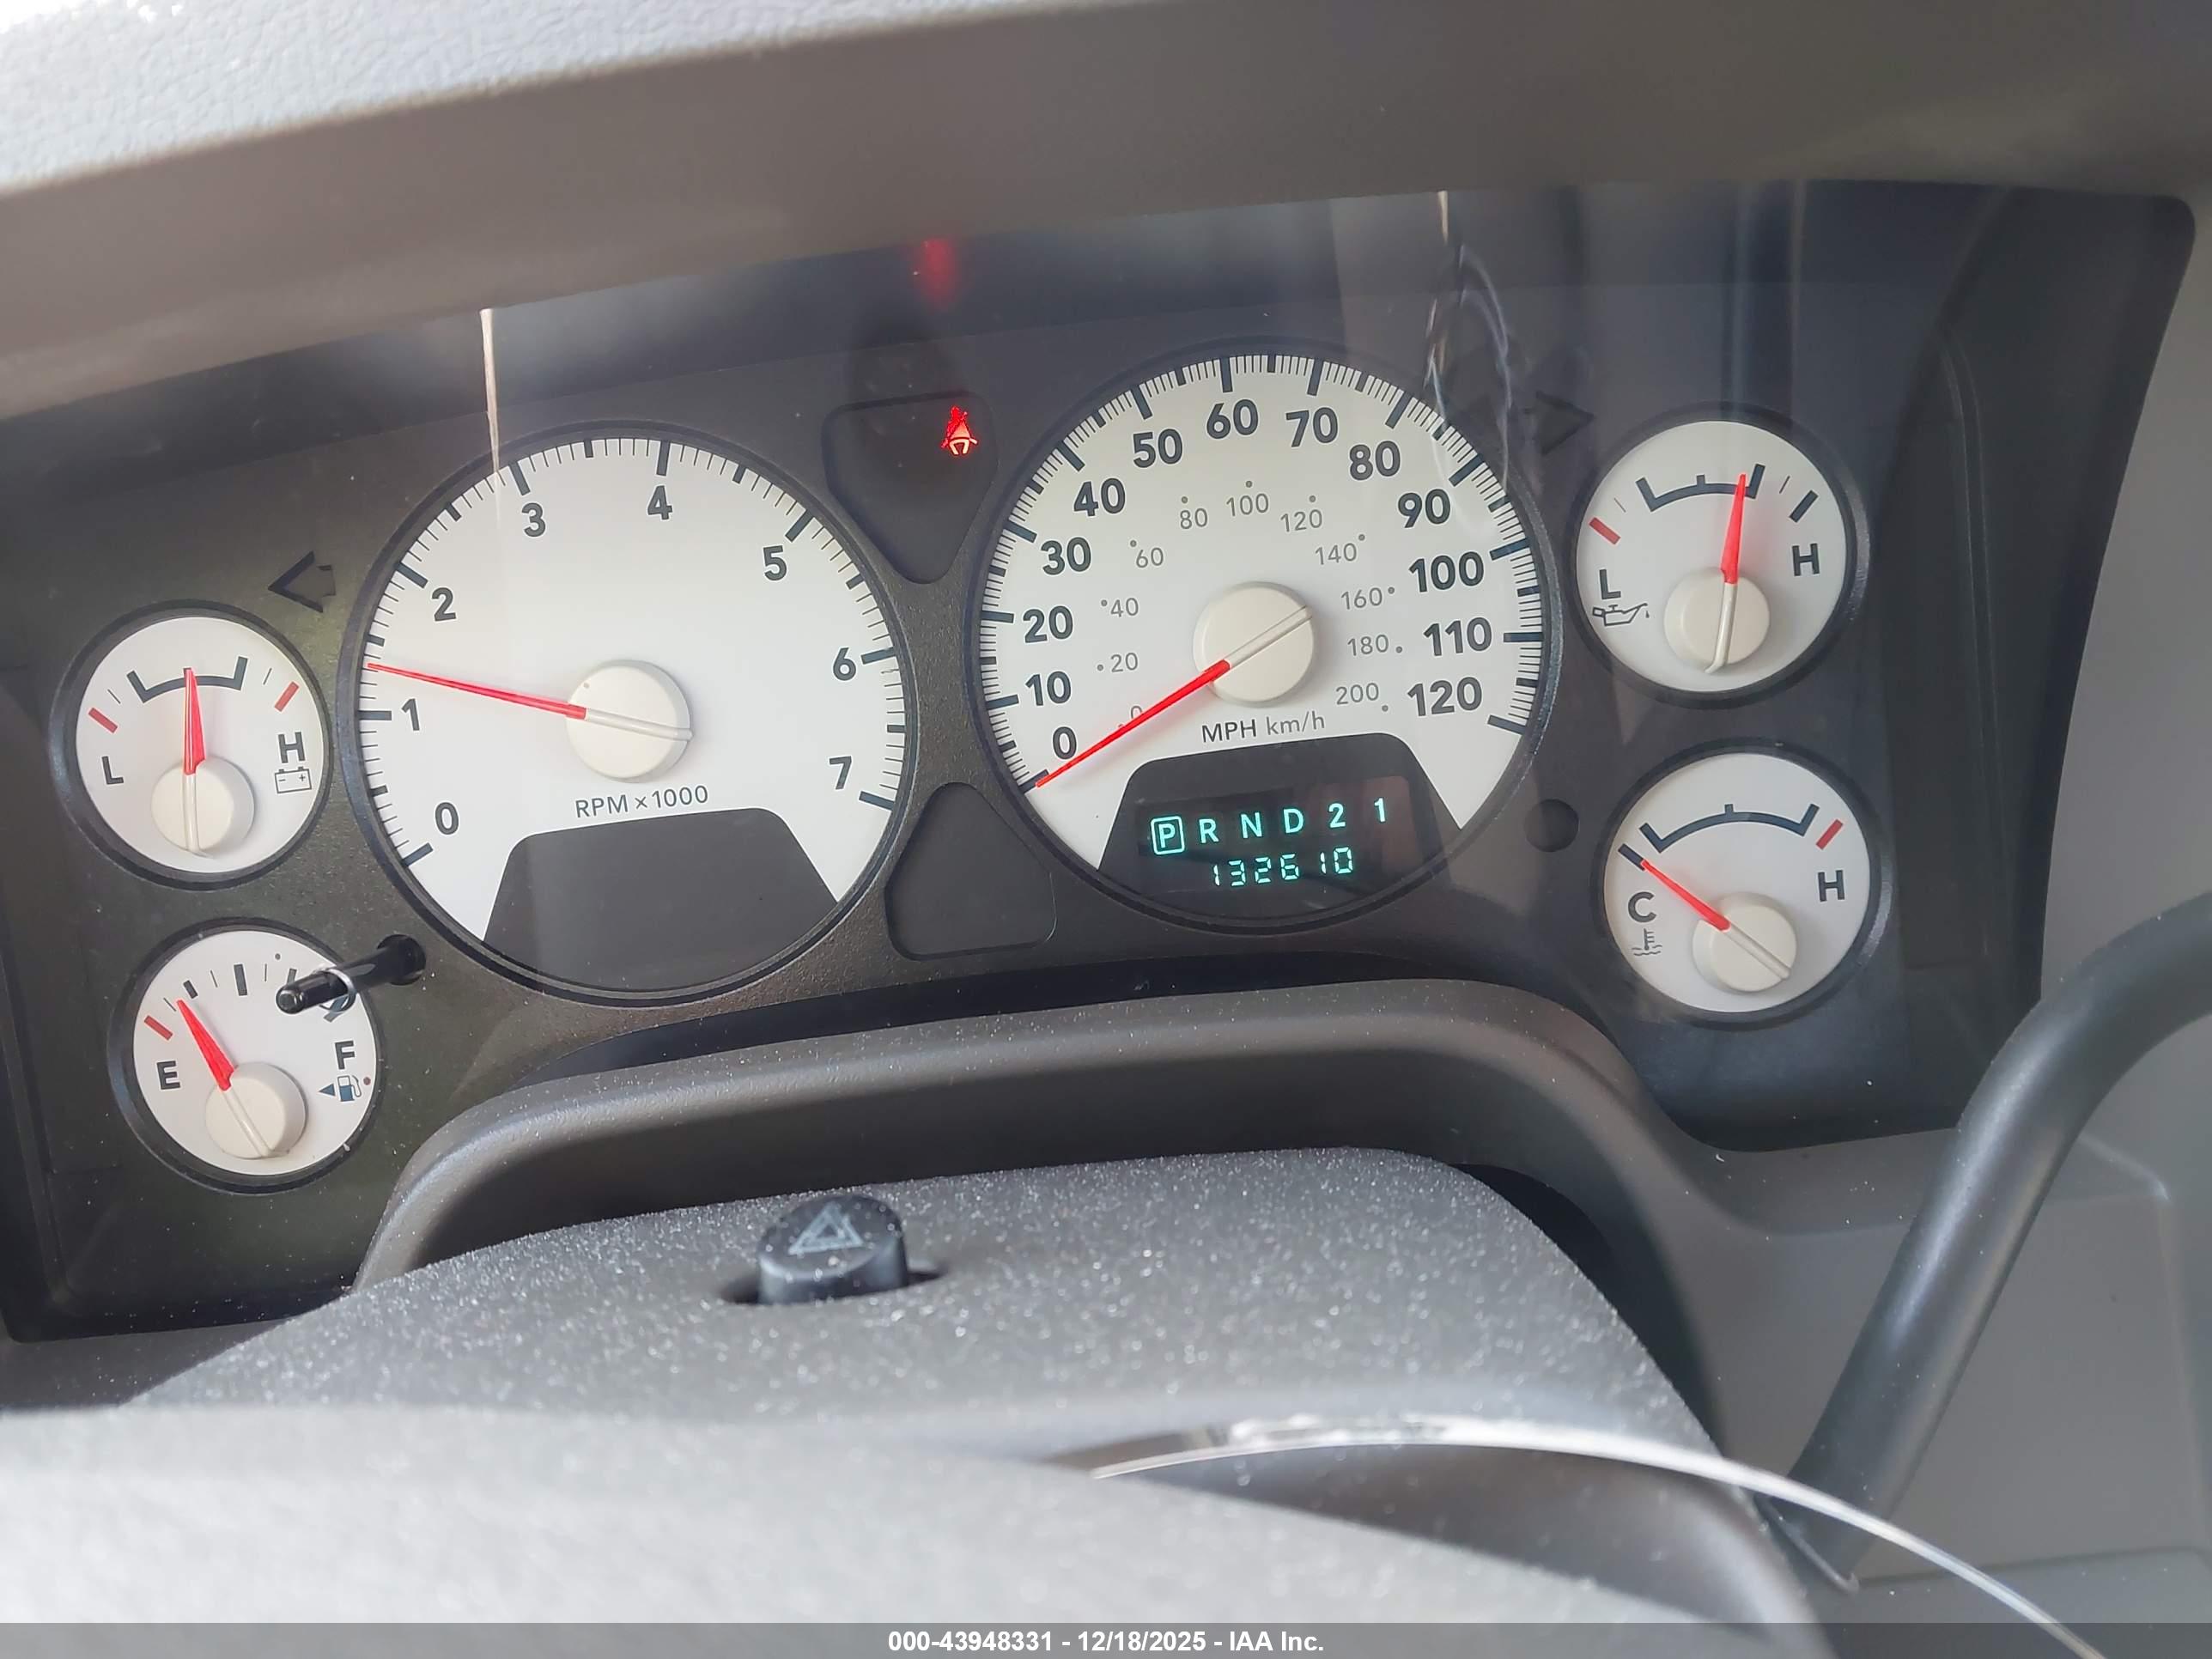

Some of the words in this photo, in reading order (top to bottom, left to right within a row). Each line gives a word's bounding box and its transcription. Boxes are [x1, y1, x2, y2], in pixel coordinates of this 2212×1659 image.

[1206, 400, 1259, 438] 60
[1286, 408, 1338, 447] 70
[1133, 429, 1182, 468] 50
[1349, 441, 1401, 479] 80
[647, 485, 672, 520] 4
[1073, 478, 1125, 516] 40
[1226, 494, 1269, 515] 100
[1397, 489, 1450, 528] 90
[521, 503, 546, 537] 3
[1180, 508, 1207, 529] 80
[1280, 510, 1322, 532] 120
[763, 546, 787, 580] 5
[1040, 538, 1091, 575] 30
[1135, 548, 1164, 568] 60
[1315, 543, 1357, 565] 140
[1792, 544, 1820, 575] H
[1409, 552, 1484, 592] 100
[1599, 568, 1621, 599] L
[432, 587, 456, 621] 2
[1110, 598, 1139, 617] 40
[1340, 587, 1382, 610] 160
[1023, 606, 1073, 643] 20
[1423, 617, 1492, 656] 110
[1347, 635, 1389, 656] 180
[832, 647, 856, 680] 6
[1110, 653, 1139, 673] 20
[1025, 671, 1071, 706] 10
[1335, 683, 1379, 705] 200
[1407, 678, 1482, 716] 120
[401, 699, 420, 731] 1
[1201, 719, 1256, 742] MPH
[1266, 712, 1325, 735] km/h
[277, 732, 303, 763] H
[1053, 727, 1077, 759] 0
[101, 757, 124, 784] L
[829, 757, 852, 790] 7
[434, 802, 459, 835] 0
[575, 794, 628, 818] RPM
[1158, 823, 1176, 848] P
[1199, 818, 1218, 843] R
[1241, 812, 1262, 839] N
[1284, 809, 1304, 833] D
[1329, 803, 1346, 829] 2
[1375, 798, 1385, 823] 1
[1817, 871, 1844, 902] H
[1628, 892, 1656, 921] C
[334, 1041, 355, 1069] F
[156, 1061, 180, 1090] E
